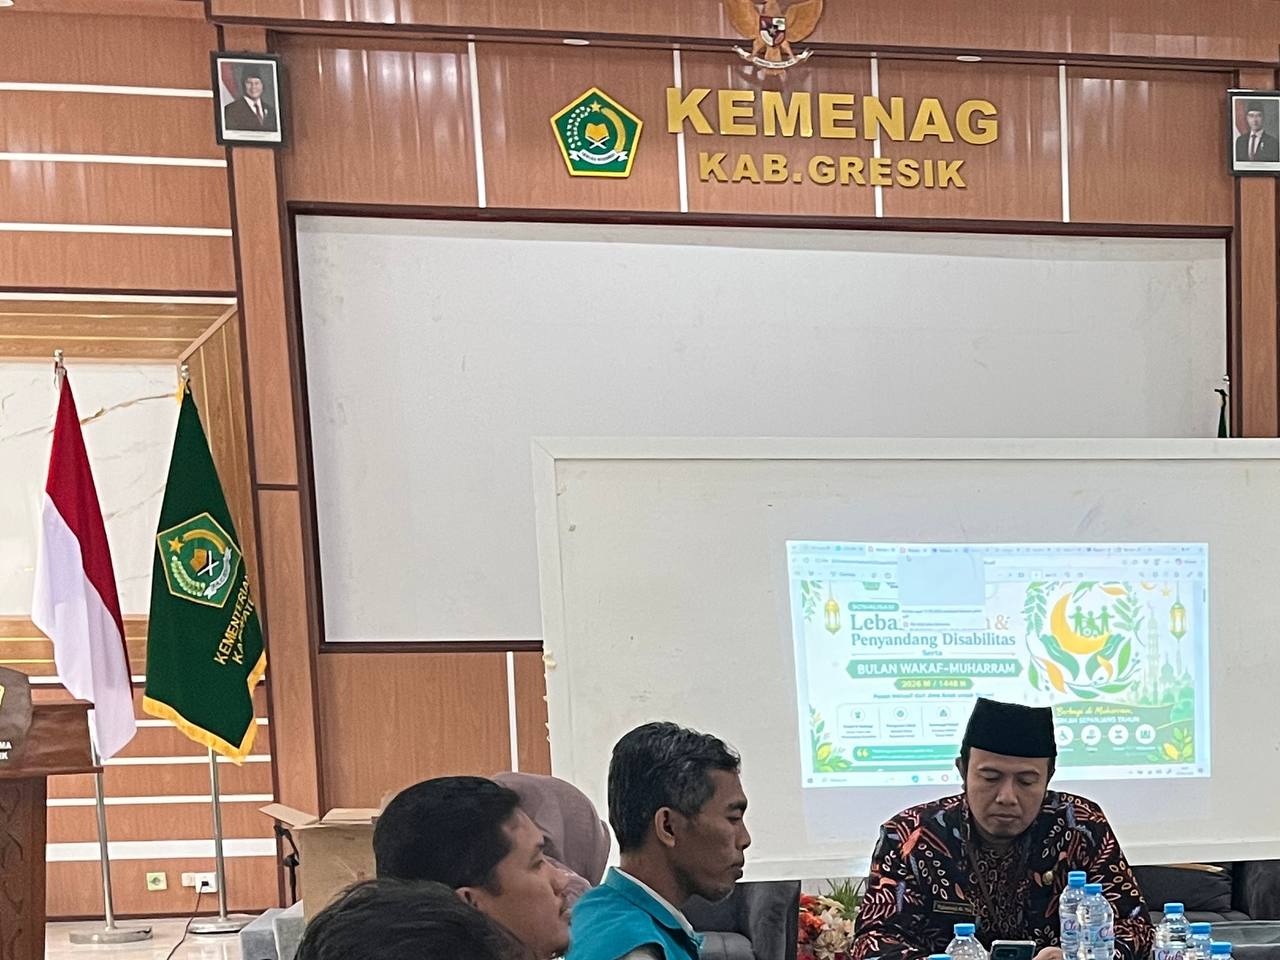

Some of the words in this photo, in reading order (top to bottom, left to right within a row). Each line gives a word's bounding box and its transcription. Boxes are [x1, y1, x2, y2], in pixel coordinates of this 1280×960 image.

[666, 88, 999, 145] KEMENAG
[700, 152, 967, 188] KAB.GRESIK
[851, 632, 938, 649] Penyandang
[942, 631, 1016, 646] Disabilitas
[921, 649, 943, 657] Serta
[857, 663, 898, 675] BULAN
[899, 662, 1016, 675] WAKAF-MUHARRAM
